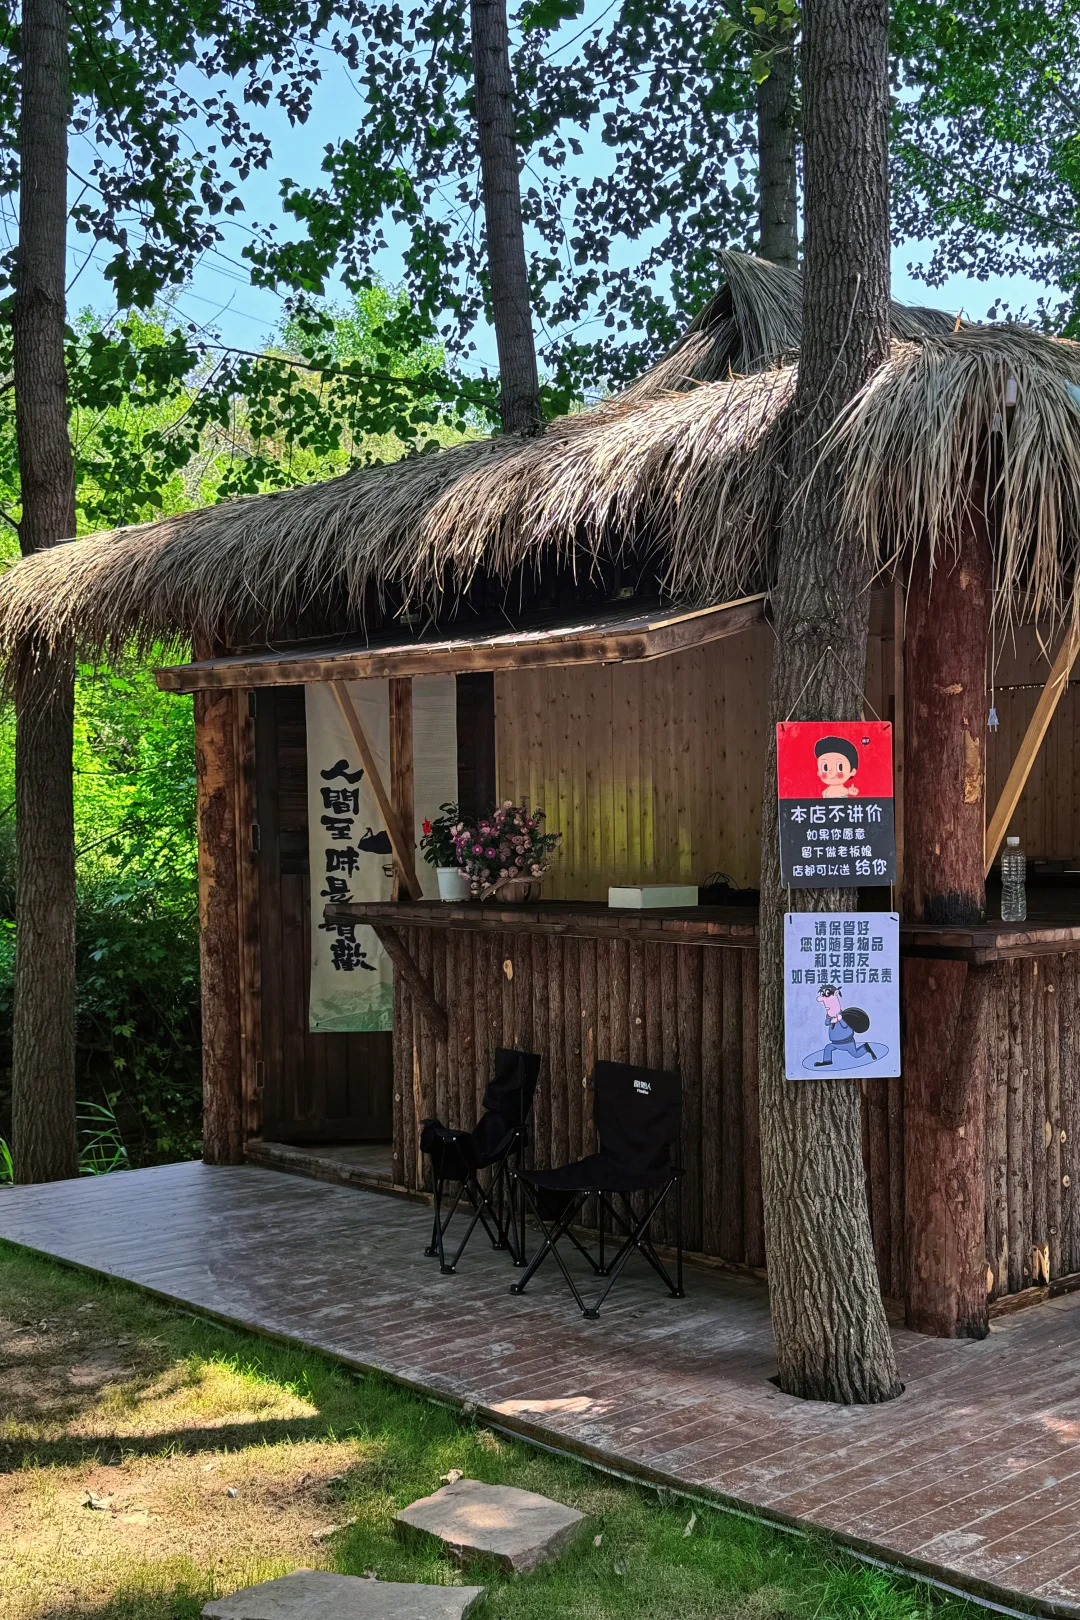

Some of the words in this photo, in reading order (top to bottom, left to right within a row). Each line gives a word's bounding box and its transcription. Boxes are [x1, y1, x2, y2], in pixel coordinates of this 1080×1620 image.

[790, 804, 883, 824] 本店不讲价
[806, 828, 866, 841] 如果你愿意
[801, 845, 872, 858] 留下做老板娘
[814, 921, 870, 936] 请保管好
[800, 936, 883, 952] 您的随身物品
[814, 953, 869, 968] 和女朋友
[791, 968, 892, 984] 如有遗失自行负责
